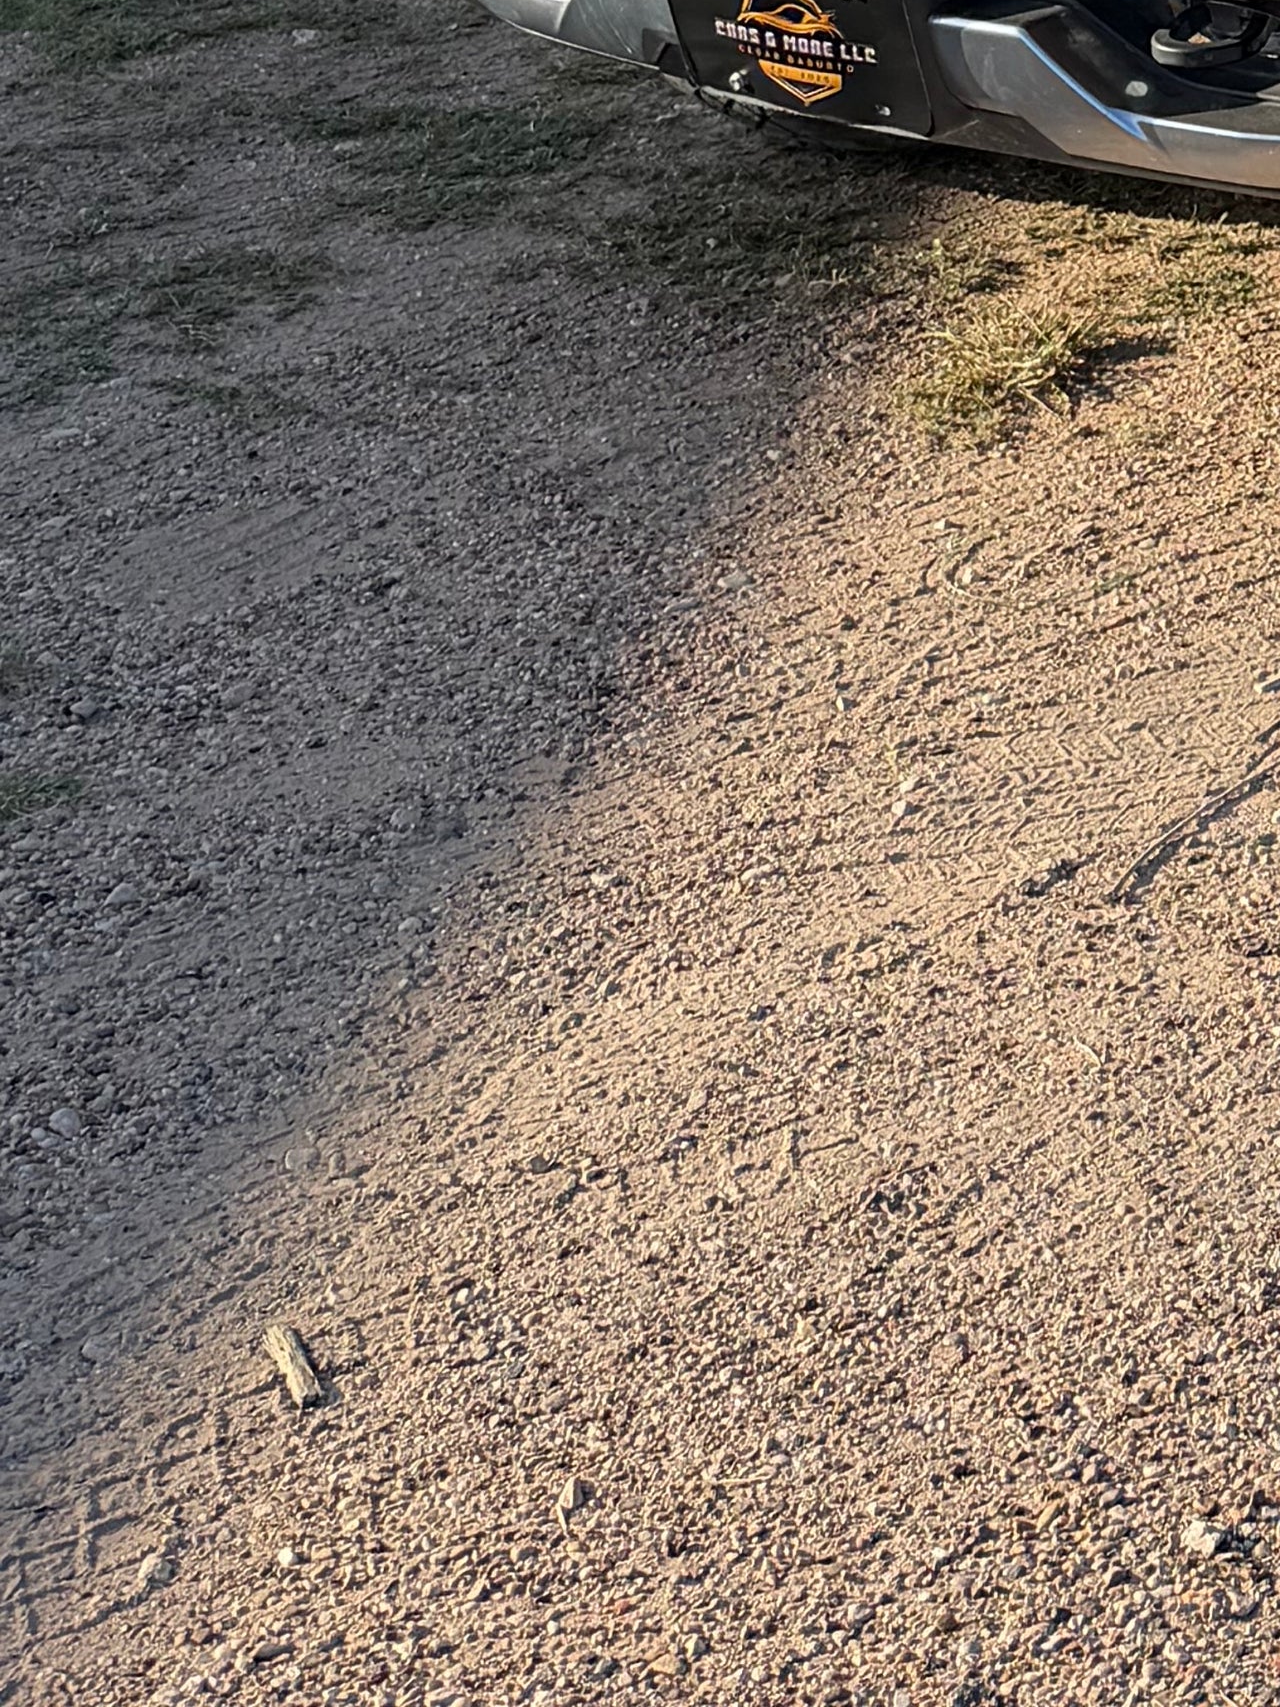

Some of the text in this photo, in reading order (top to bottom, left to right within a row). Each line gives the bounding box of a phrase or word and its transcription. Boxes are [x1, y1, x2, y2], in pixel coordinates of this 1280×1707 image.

[714, 19, 761, 45] CARS
[783, 34, 834, 58] MORE
[840, 43, 878, 64] LLC
